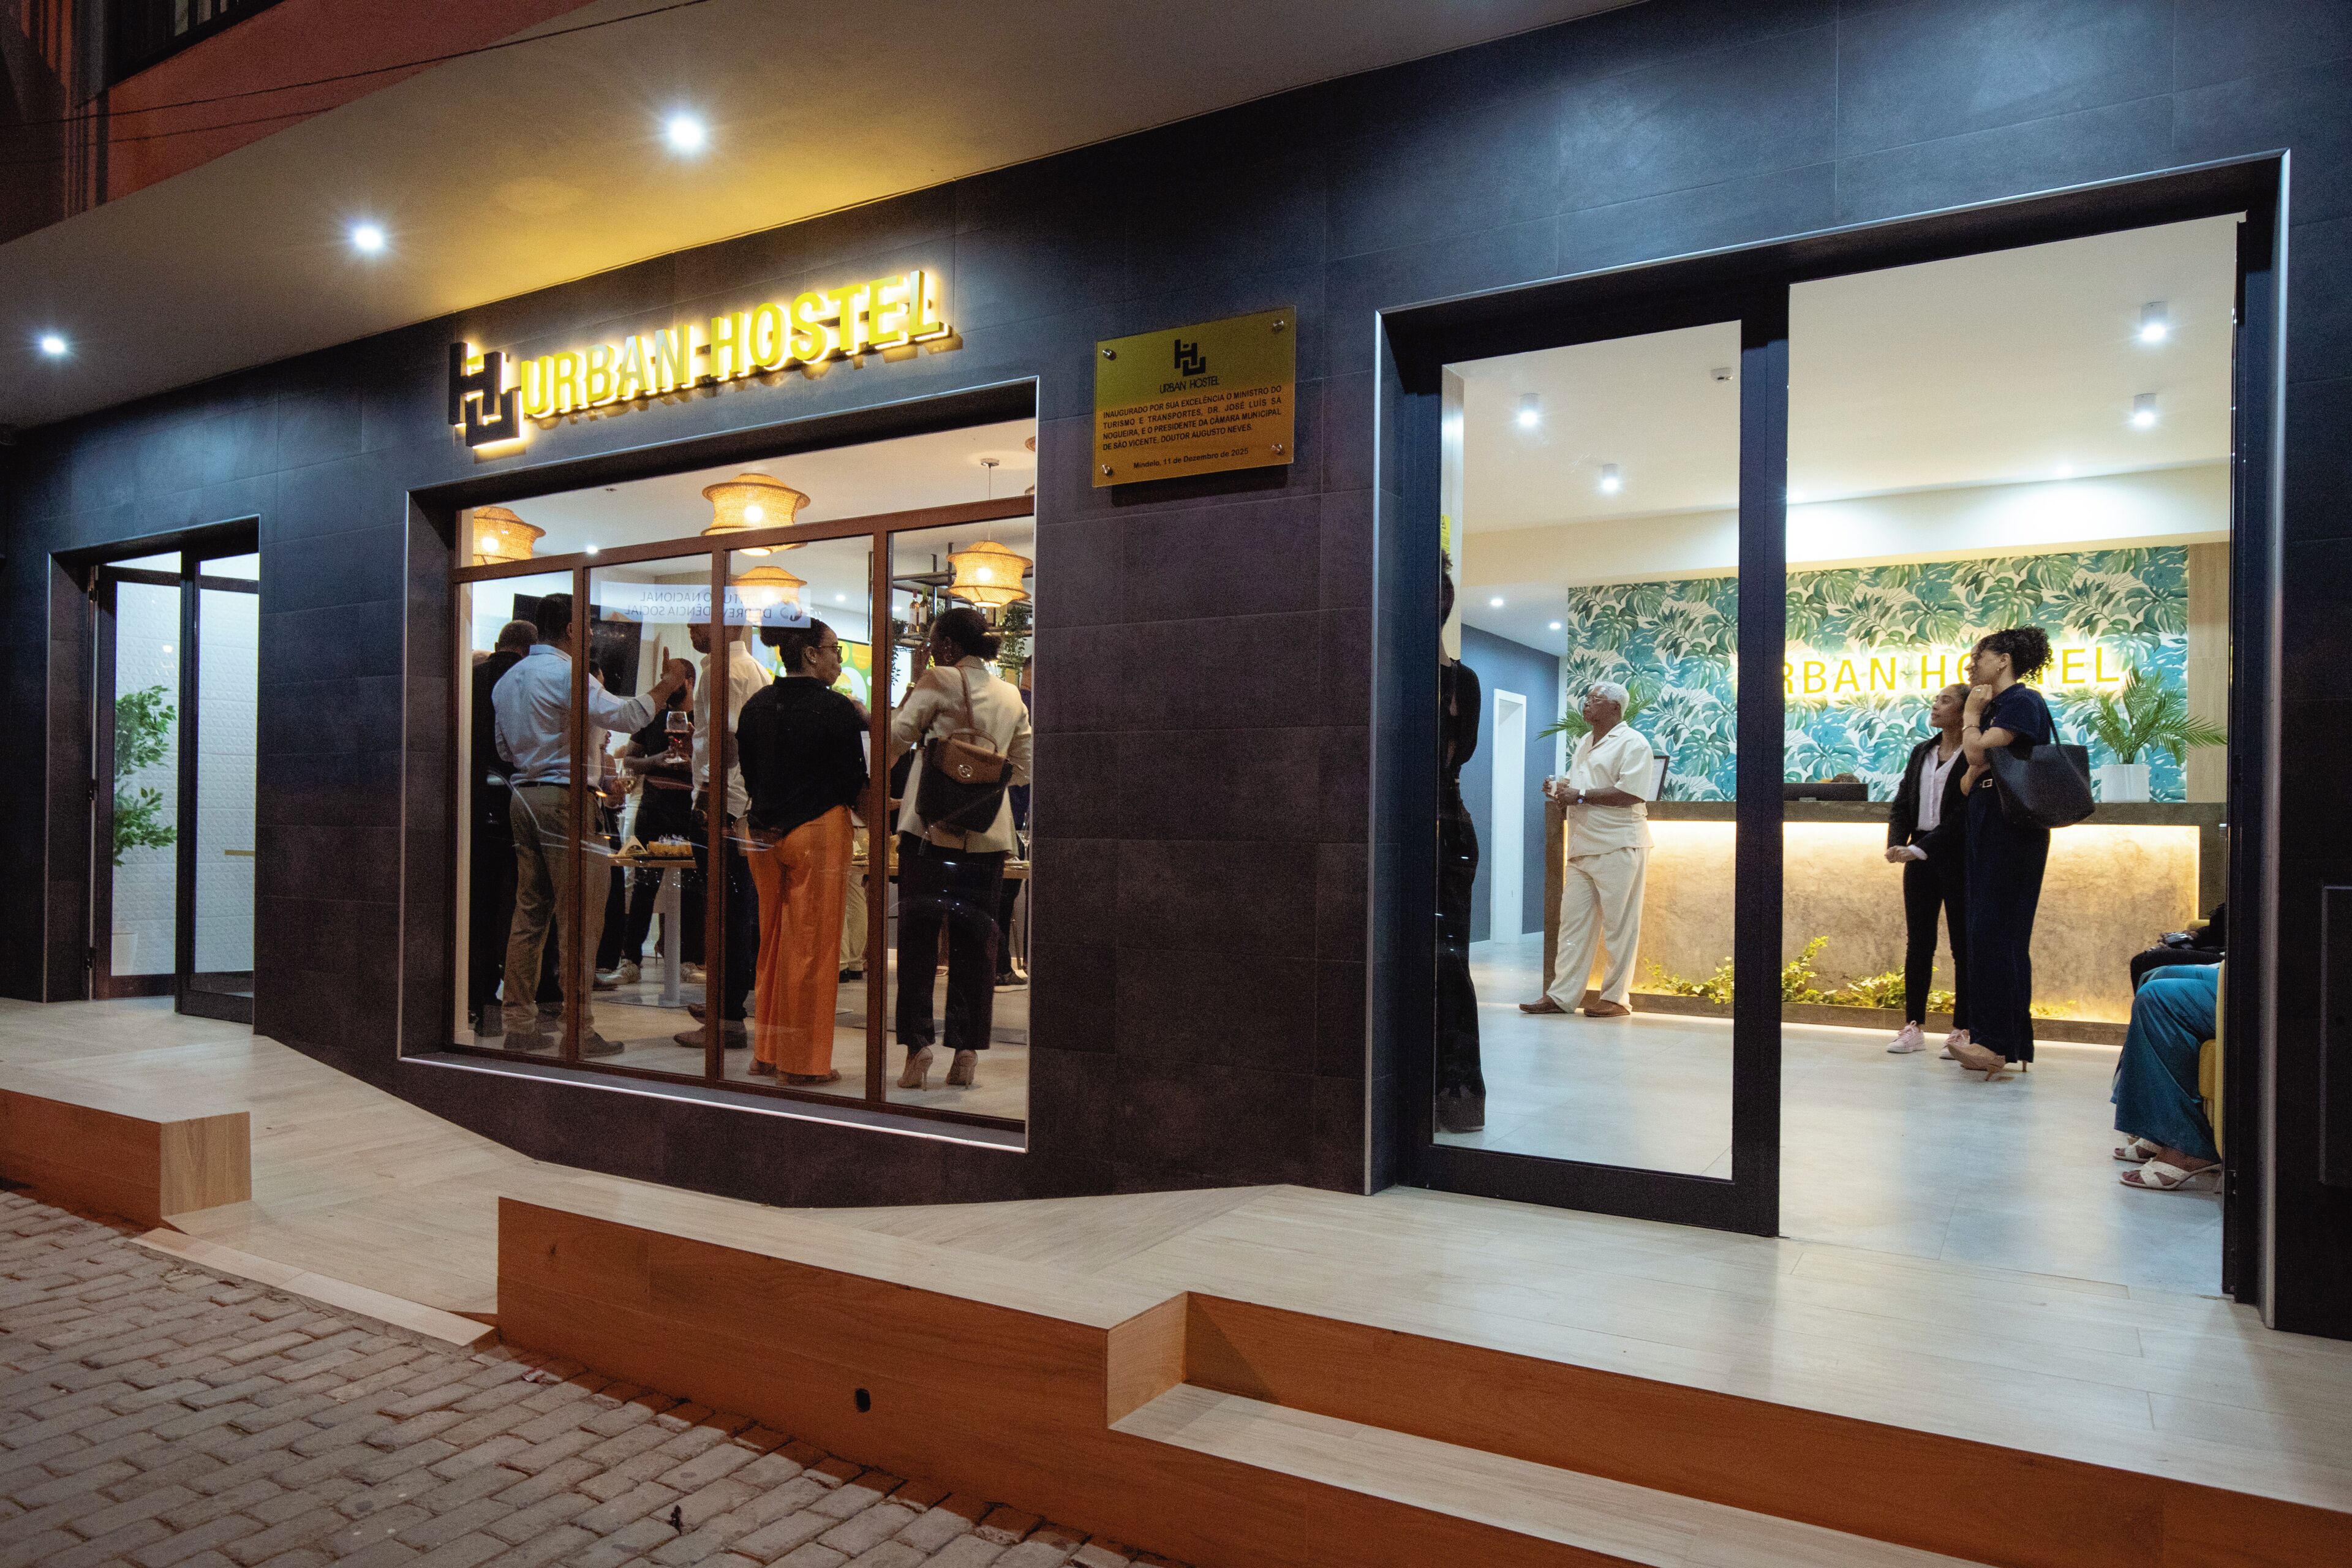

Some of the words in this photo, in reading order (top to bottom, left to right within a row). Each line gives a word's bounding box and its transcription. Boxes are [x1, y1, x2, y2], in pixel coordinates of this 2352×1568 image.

[521, 323, 693, 416] URBAN
[710, 270, 949, 380] HOSTEL
[1159, 381, 1186, 394] URBAN
[1189, 375, 1220, 389] HOSTEL
[1103, 405, 1148, 418] INAUGURADO
[1234, 387, 1269, 399] MINISTRO
[1103, 418, 1135, 429] TURISMO
[1147, 408, 1203, 423] TRANSPORTES,
[1224, 401, 1245, 412] JOSÉ
[1249, 399, 1267, 408] LUÍS
[1271, 394, 1282, 404] SÁ
[1103, 429, 1140, 440] NOGUEIRA,
[1154, 421, 1196, 432] PRESIDENTE
[1210, 415, 1240, 425] CÂMARA
[1242, 408, 1282, 420] MUNICIPAL
[1113, 440, 1128, 449] SÃO
[1161, 432, 1190, 443] DOUTOR
[1192, 427, 1226, 439] AUGUSTO
[1183, 453, 1218, 463] Dezembro
[1231, 448, 1249, 456] 2025
